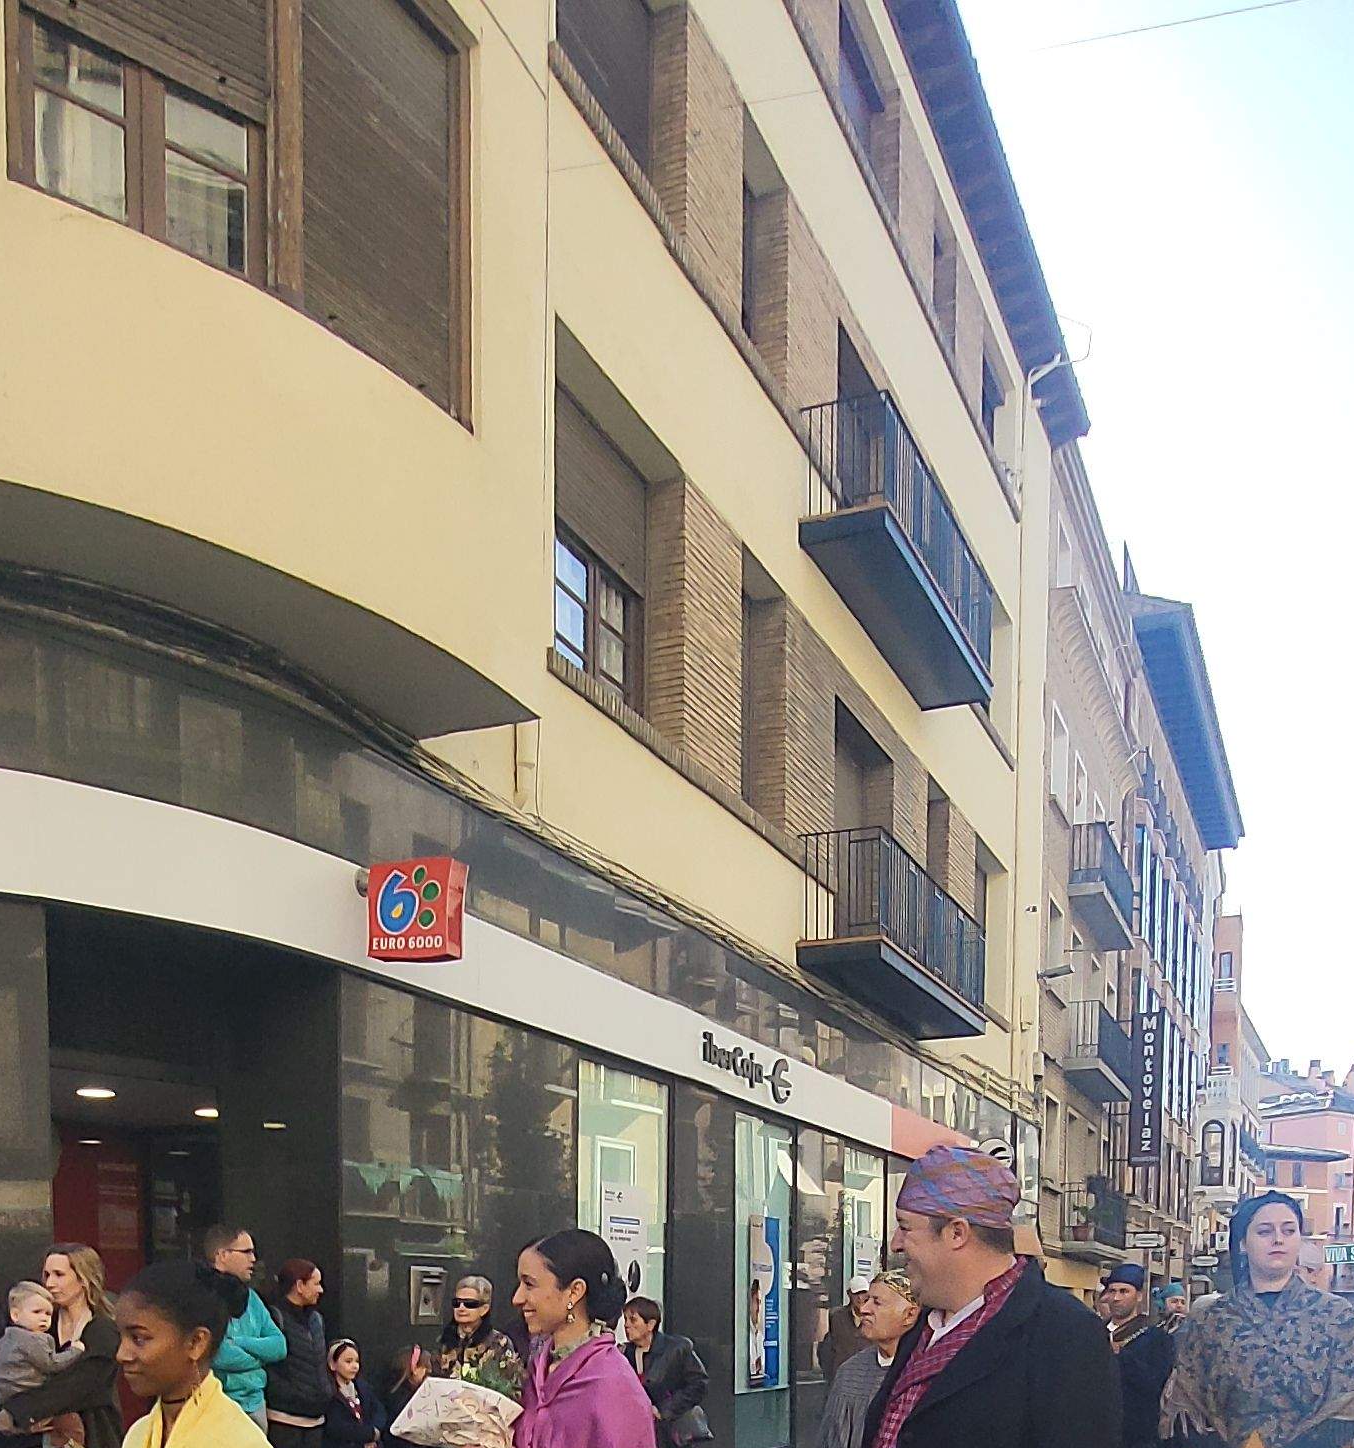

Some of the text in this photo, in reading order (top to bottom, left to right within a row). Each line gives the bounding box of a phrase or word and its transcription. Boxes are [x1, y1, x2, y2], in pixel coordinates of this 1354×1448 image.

[372, 935, 444, 951] EURO 6000
[1140, 1016, 1158, 1152] Montovelaz
[1326, 1247, 1347, 1262] VIVA
